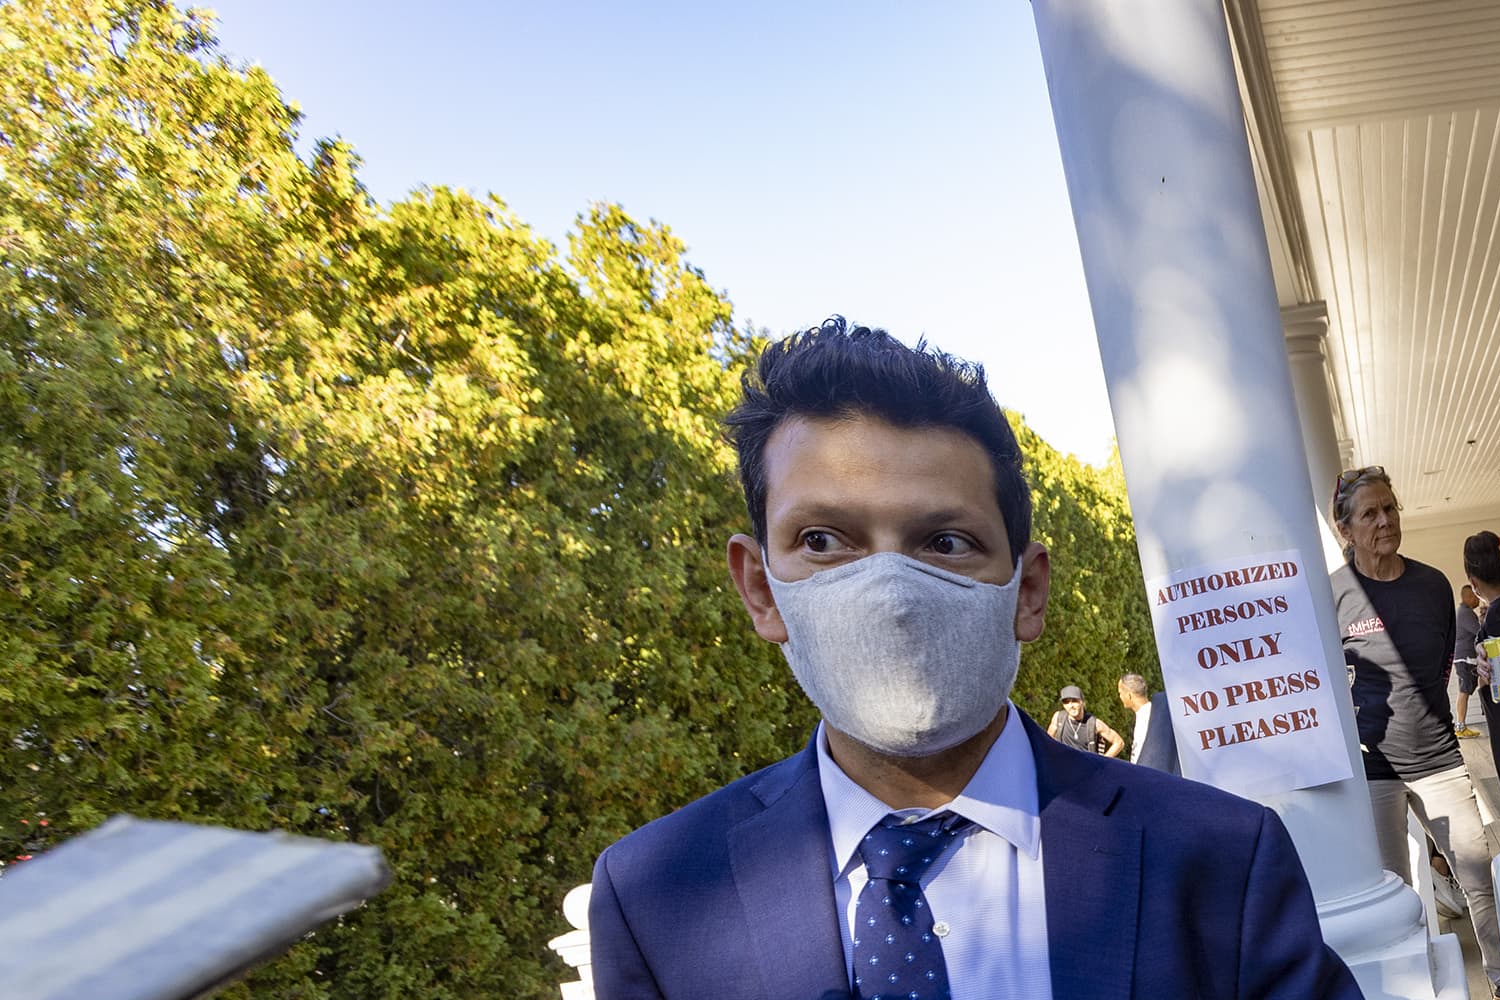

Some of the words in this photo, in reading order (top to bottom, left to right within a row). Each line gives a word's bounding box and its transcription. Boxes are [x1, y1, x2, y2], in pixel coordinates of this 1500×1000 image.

[1157, 561, 1298, 606] AUTHORIZED
[1176, 595, 1289, 634] PERSONS
[1197, 632, 1282, 670] ONLY
[1180, 690, 1219, 717] NO
[1223, 668, 1321, 708] PRESS
[1198, 707, 1320, 751] PLEASE!
